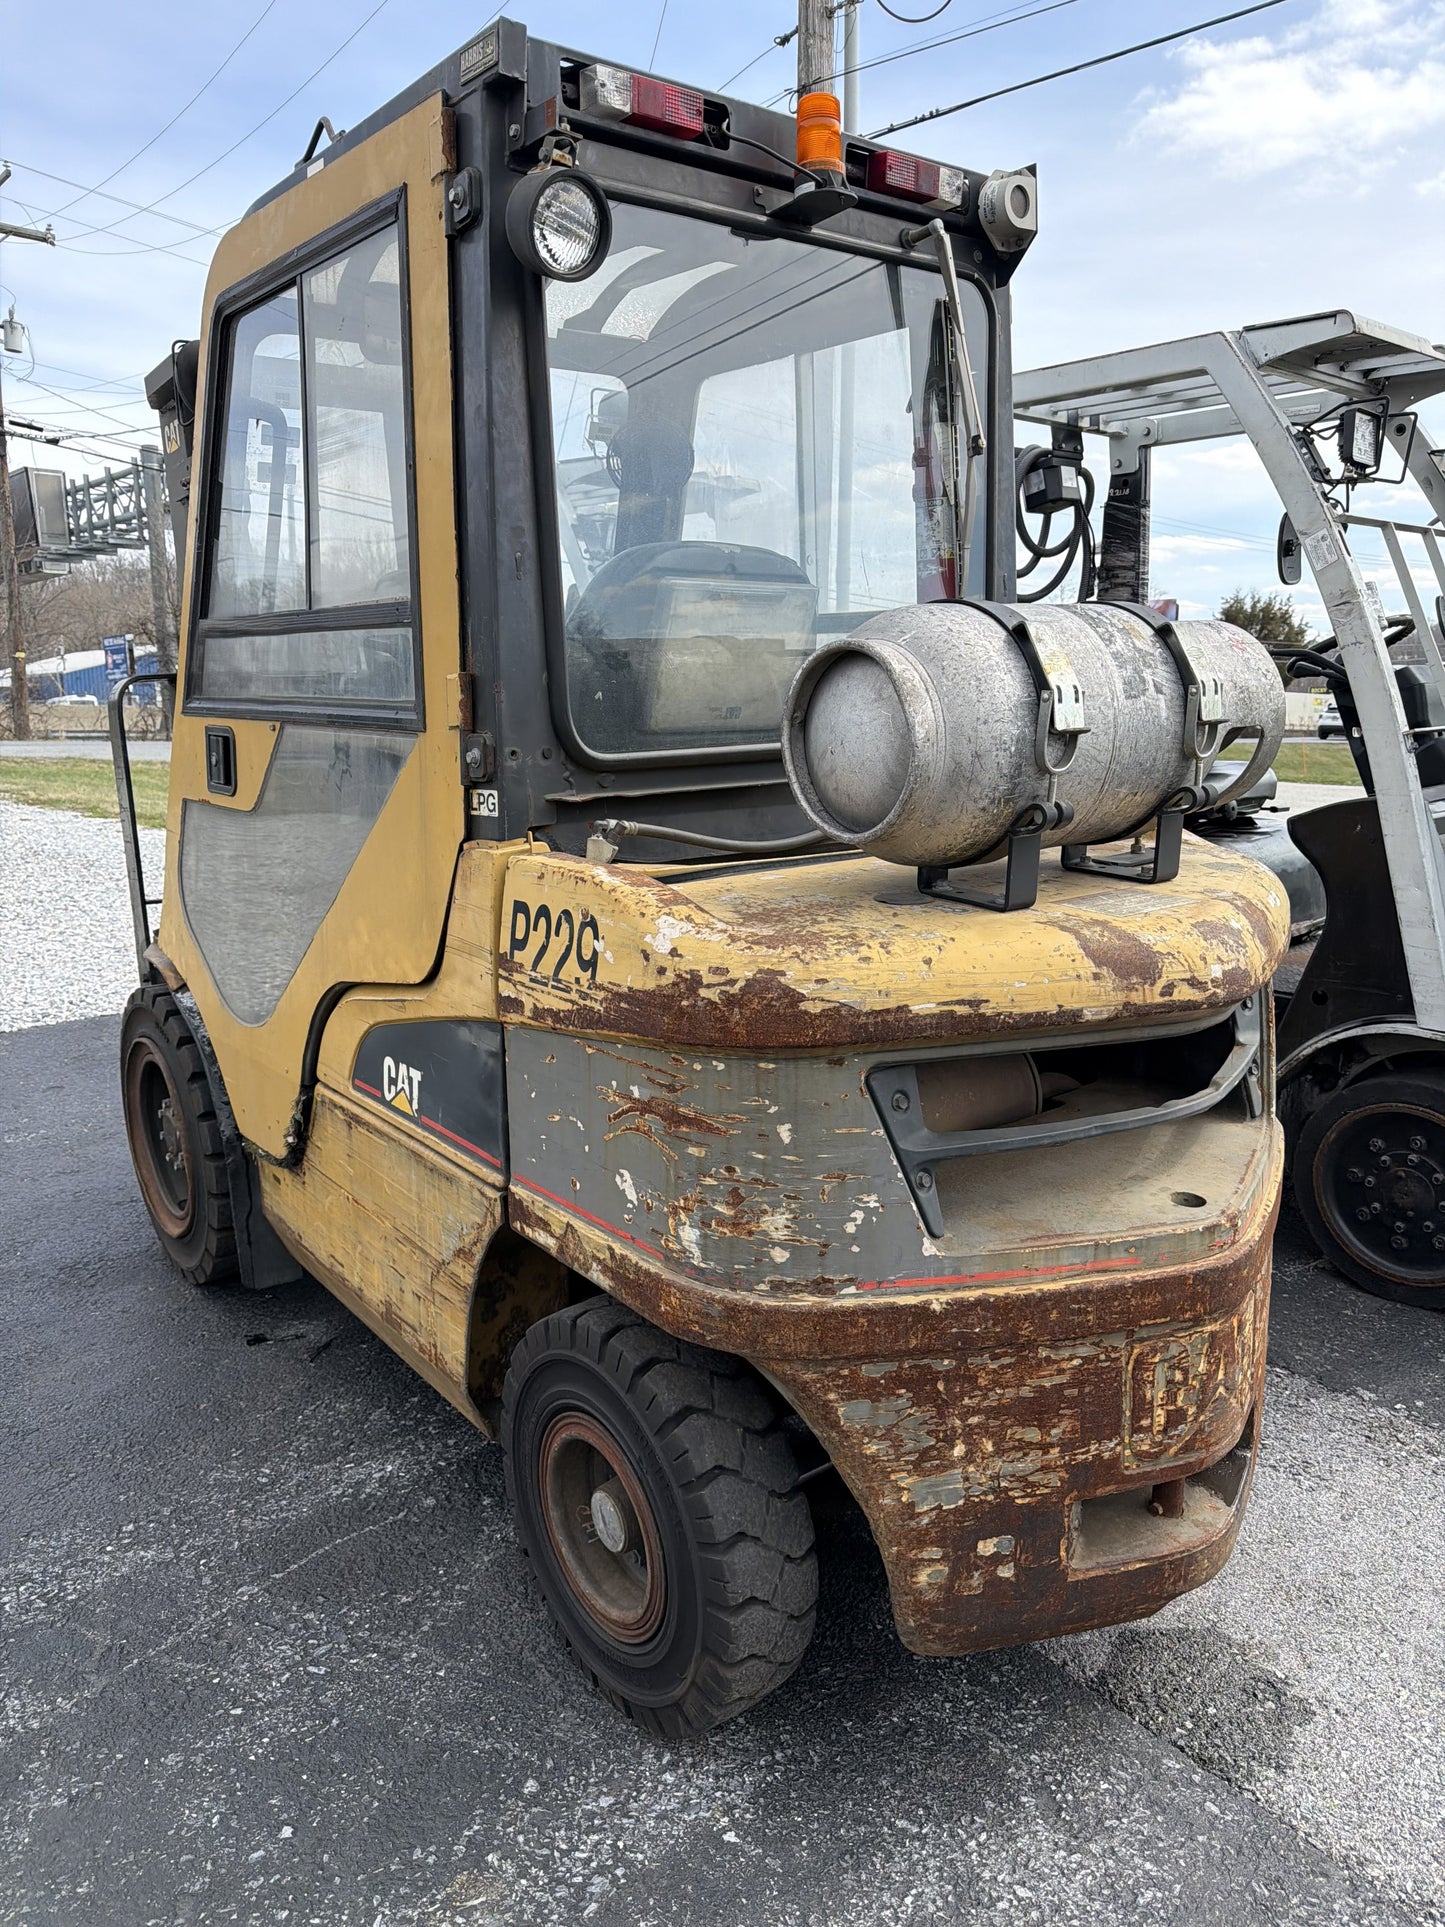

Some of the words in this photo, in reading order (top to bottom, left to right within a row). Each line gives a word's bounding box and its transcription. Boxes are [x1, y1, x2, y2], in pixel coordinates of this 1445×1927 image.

[164, 419, 180, 454] CAT
[470, 792, 496, 813] LPG
[509, 899, 599, 993] P229
[383, 1056, 421, 1117] CAT
